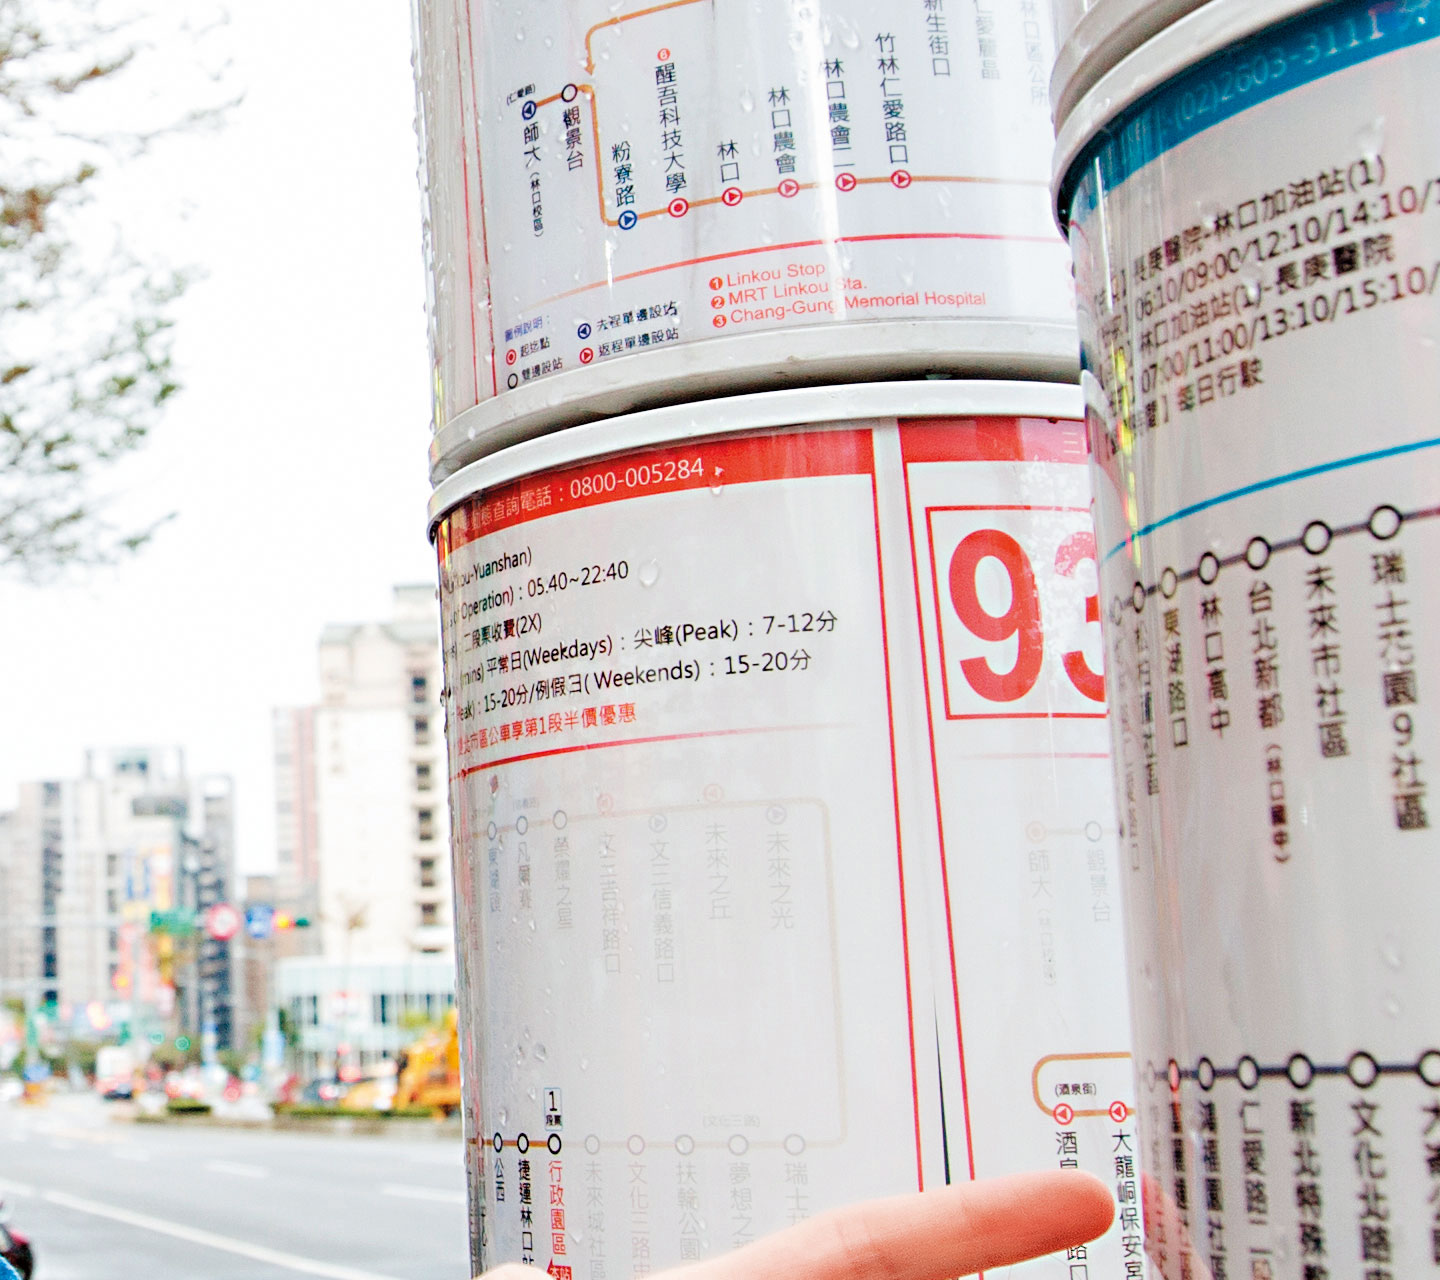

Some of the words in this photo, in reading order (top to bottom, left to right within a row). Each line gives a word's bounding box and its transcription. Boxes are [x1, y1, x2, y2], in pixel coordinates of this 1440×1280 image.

[655, 61, 689, 195] 醒吾科技大學
[767, 85, 797, 175] 林口農會
[822, 56, 856, 168] 林口農會二
[873, 31, 909, 165] 竹林仁愛路口
[523, 121, 542, 170] 師大
[562, 105, 584, 172] 觀景台
[716, 139, 741, 184] 林口
[611, 139, 636, 208] 粉寮路
[726, 267, 782, 289] Linkou
[786, 262, 827, 282] Stop
[728, 286, 768, 307] MRT
[773, 280, 831, 300] Linkou
[836, 276, 868, 291] Sta.
[730, 297, 839, 325] Chang-Gung
[843, 291, 920, 310] Memorial
[923, 290, 987, 308] Hospital
[597, 326, 680, 358] 返程單邊設站
[463, 612, 542, 654] 二段票收費(2X)
[1370, 548, 1432, 833] 瑞士花園9社區
[703, 822, 733, 923] 未來之丘
[765, 831, 796, 932] 未來之光
[1027, 849, 1052, 900] 師大
[1086, 849, 1112, 924] 觀景台
[648, 838, 676, 985] 文三信義路口
[547, 1089, 559, 1113] 1
[1054, 1082, 1098, 1098] (酒泉街)
[493, 1157, 506, 1204] 公西
[547, 1159, 568, 1257] 行政園區
[675, 1160, 702, 1263] 扶輪公園
